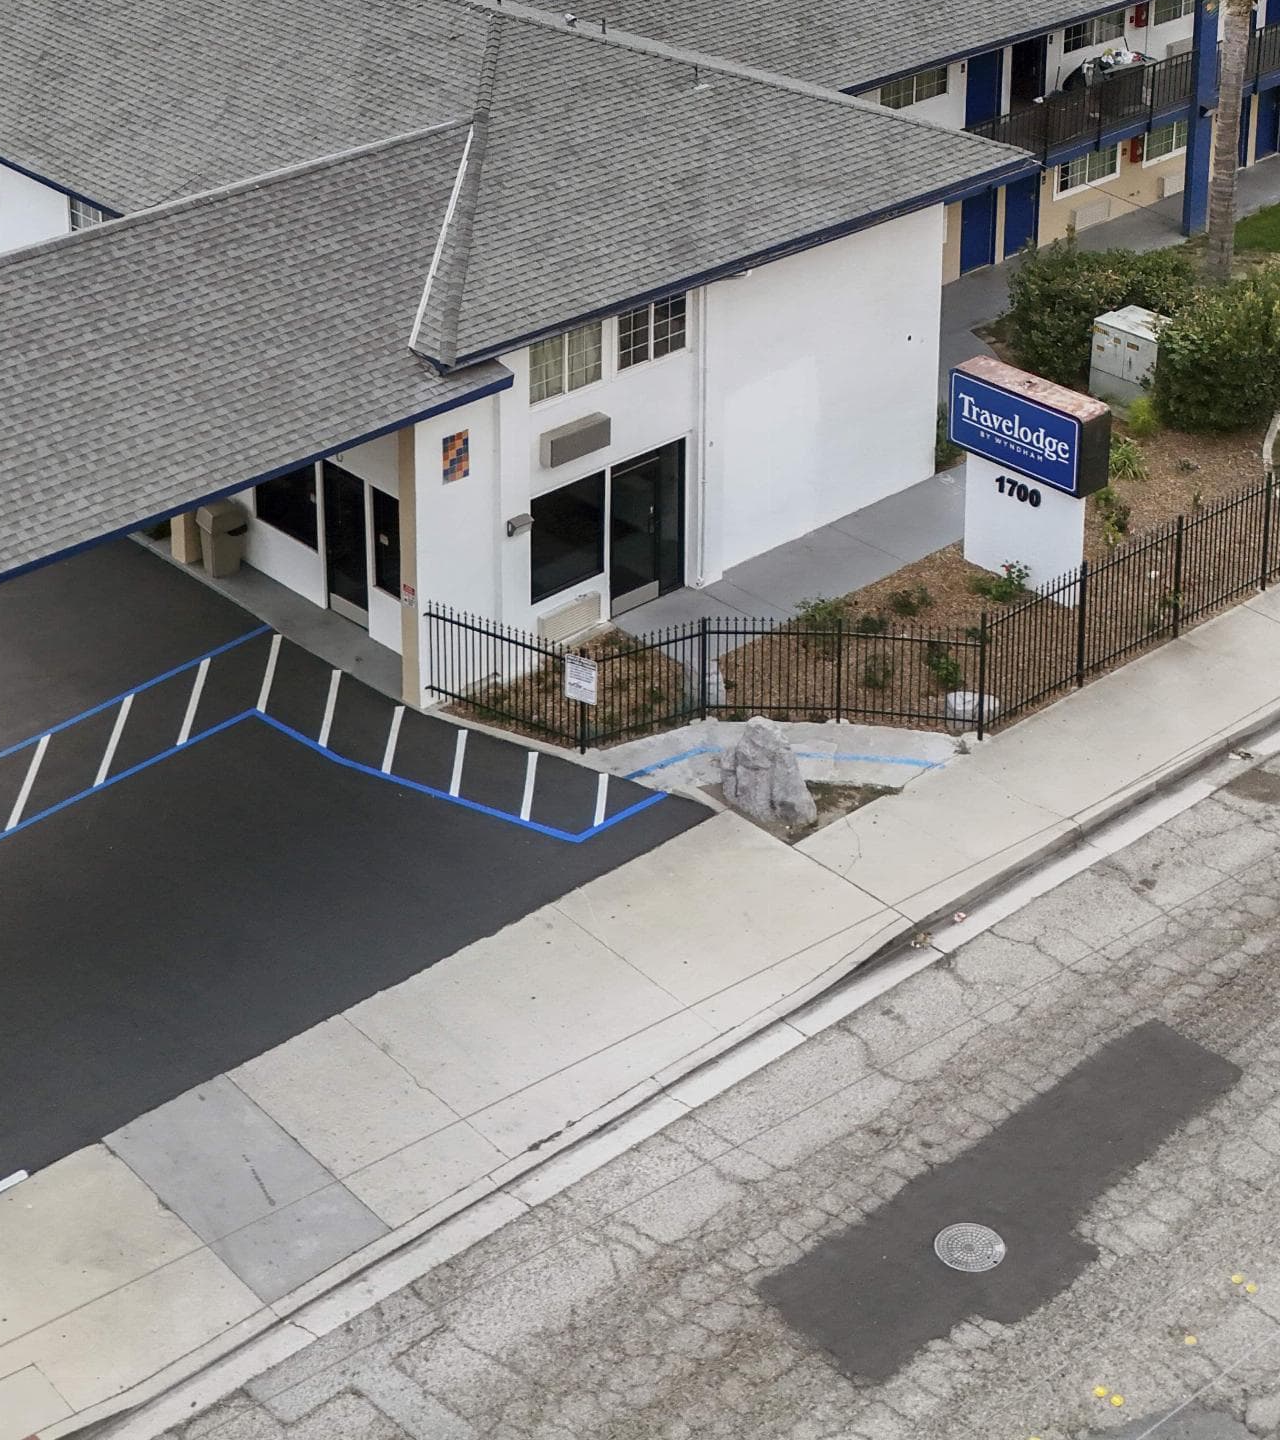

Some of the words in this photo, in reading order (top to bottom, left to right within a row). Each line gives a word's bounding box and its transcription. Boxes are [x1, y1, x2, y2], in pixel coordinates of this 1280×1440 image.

[958, 392, 1070, 461] Travelodge
[980, 430, 991, 440] BY
[994, 437, 1044, 462] WYNDHAM
[995, 475, 1041, 507] 1700
